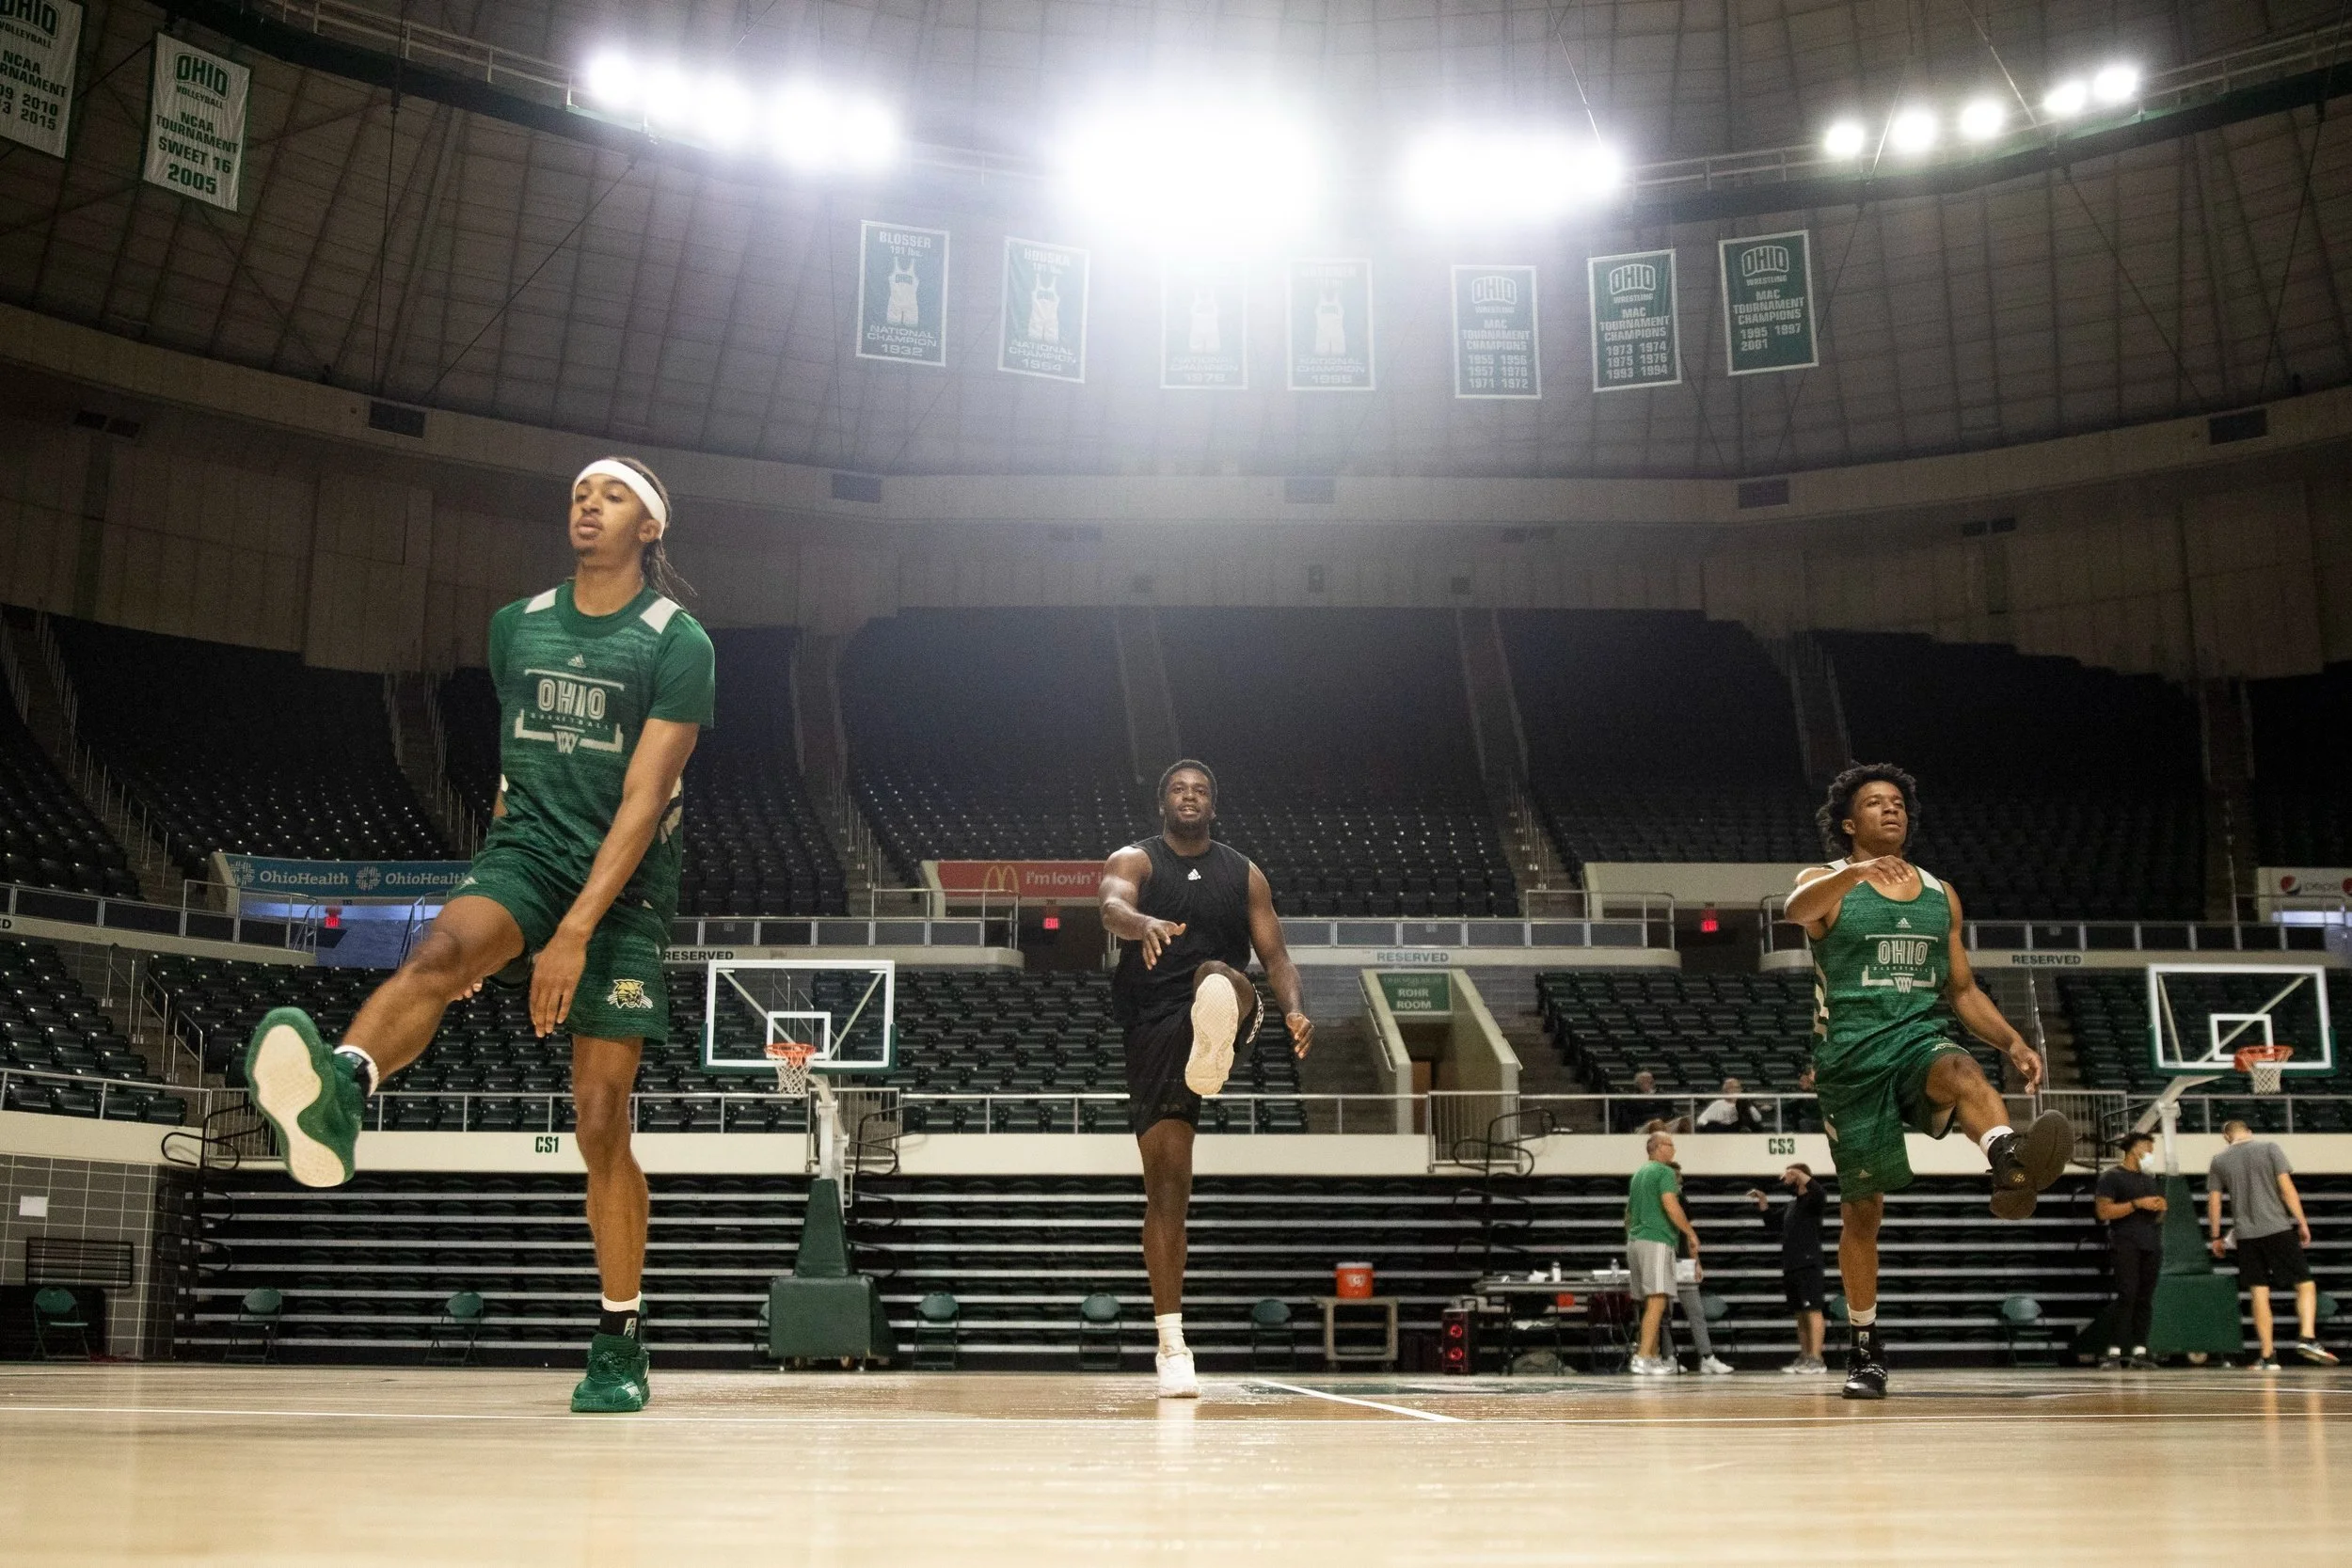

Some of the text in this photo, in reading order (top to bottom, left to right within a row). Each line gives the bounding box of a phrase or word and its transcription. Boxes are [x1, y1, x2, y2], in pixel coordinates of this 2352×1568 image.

[4, 50, 40, 74] NCAA
[175, 54, 229, 99] OHIO
[177, 84, 223, 110] VOLLEYBALL
[23, 94, 58, 116] 2010
[21, 108, 56, 131] 2015
[181, 112, 215, 134] NCAA
[156, 114, 239, 154] TOURNAMENT
[158, 135, 231, 174] SWEET 16
[167, 162, 217, 196] 2005
[879, 230, 931, 249] BLOSSER
[1742, 245, 1789, 277] OHIO
[1610, 263, 1656, 294] OHIO
[1746, 275, 1788, 286] WRESTLING
[1472, 276, 1516, 305] OHIO
[1614, 293, 1654, 303] WRESTLING
[1756, 289, 1781, 301] MAC
[1622, 307, 1646, 319] MAC
[1732, 296, 1804, 315] TOURNAMENT
[1484, 319, 1507, 329] MAC
[1599, 315, 1670, 332] TOURNAMENT
[1738, 309, 1802, 325] CHAMPIONS
[866, 332, 937, 347] CHAMPION
[869, 325, 934, 339] NATIONAL
[1462, 329, 1531, 340] TOURNAMENT
[1604, 326, 1666, 341] CHAMPIONS
[881, 343, 923, 356] 1932
[1011, 340, 1074, 356] NATIONAL
[1467, 340, 1527, 351] CHAMPIONS
[1606, 341, 1667, 356] 1973 1974
[1740, 339, 1769, 352] 2001
[1009, 346, 1076, 364] CHAMPION
[1606, 353, 1667, 368] 1975 1976
[1170, 363, 1239, 372] CHAMPION
[1296, 365, 1366, 373] CHAMPION
[1502, 378, 1528, 388] 1972
[538, 678, 606, 721] OHIO
[531, 712, 610, 731] BASKETBALL
[260, 870, 349, 885] OhioHealth
[1025, 871, 1050, 885] I'm
[1052, 871, 1096, 885] lovin'
[663, 950, 734, 960] RESERVED
[1376, 952, 1449, 962] RESERVED
[1878, 940, 1929, 965] OHIO
[2011, 955, 2081, 964] RESERVED
[1397, 989, 1429, 998] ROHR
[1396, 1000, 1432, 1009] ROOM
[535, 1136, 559, 1153] CS1
[1769, 1138, 1794, 1154] CS3
